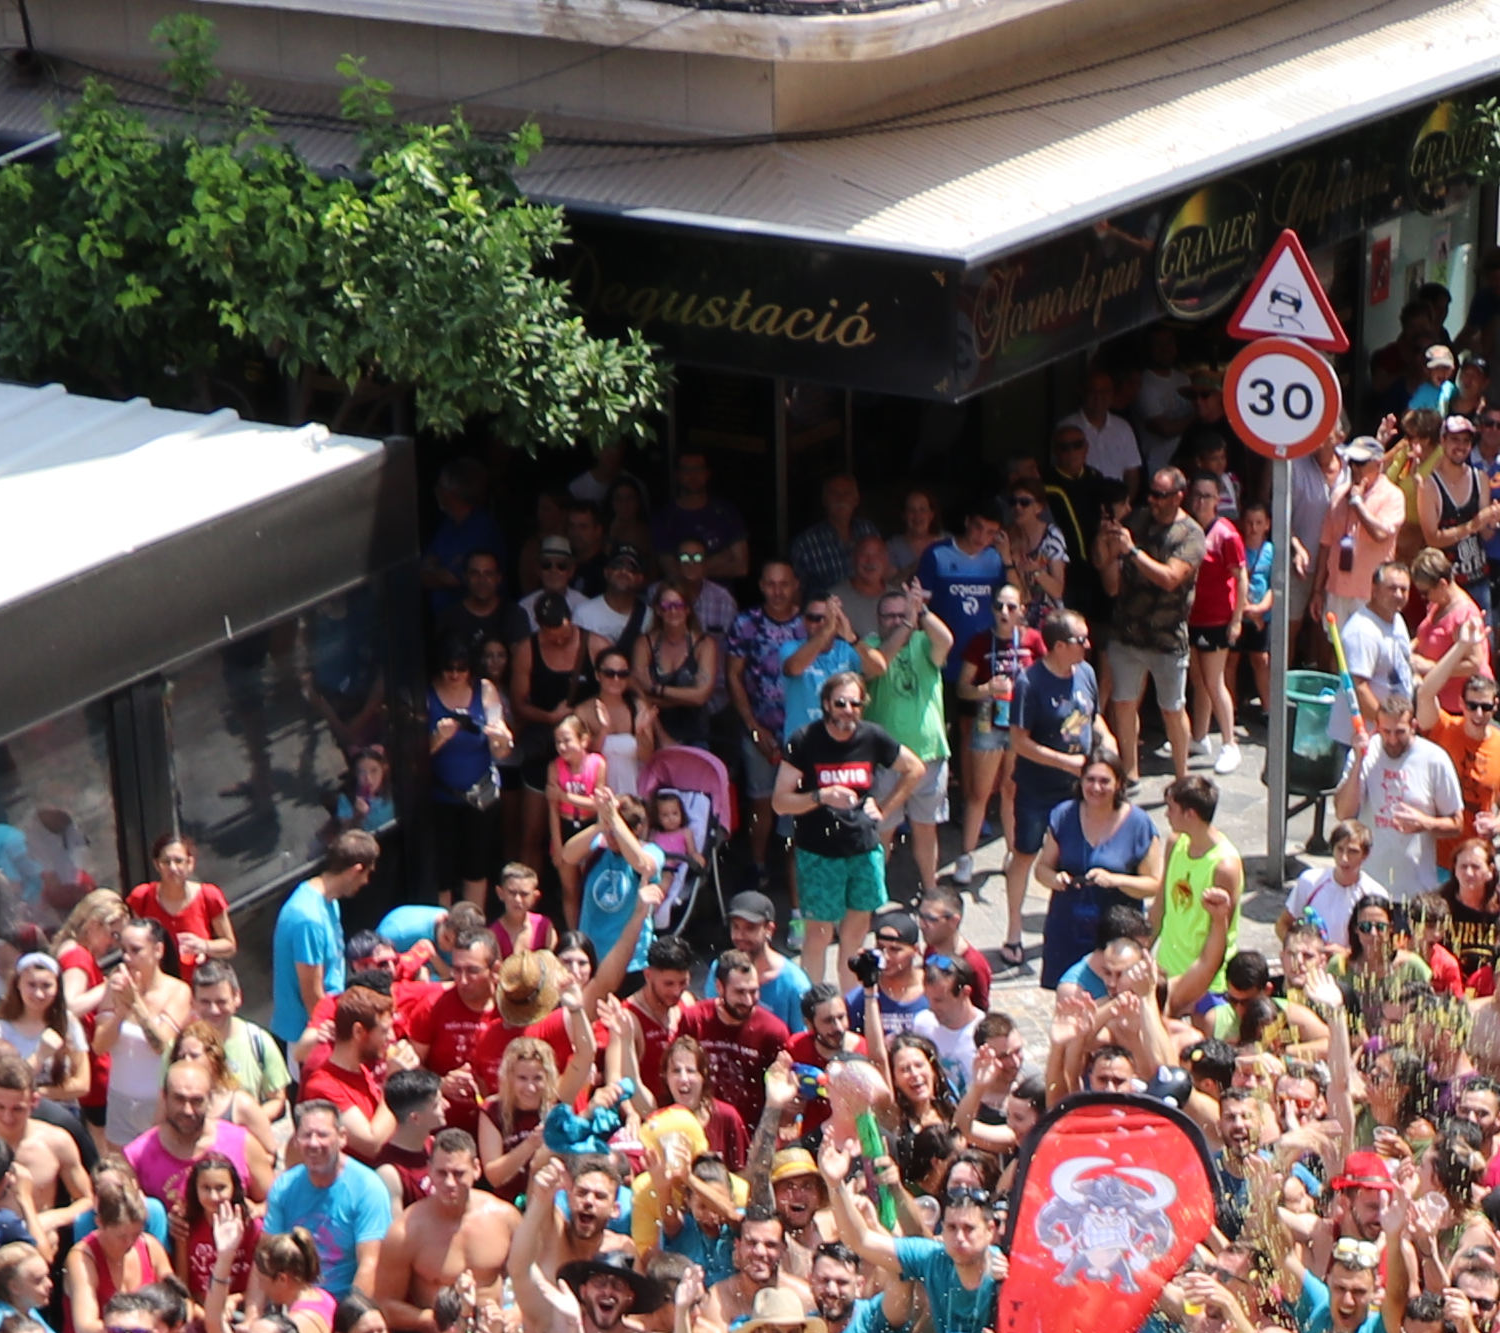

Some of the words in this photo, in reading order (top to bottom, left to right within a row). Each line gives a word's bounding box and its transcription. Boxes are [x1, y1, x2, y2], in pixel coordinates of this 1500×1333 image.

[1161, 211, 1257, 280] GRANIER
[1069, 252, 1096, 314] de
[1093, 256, 1141, 328] pan
[1248, 377, 1313, 421] 30
